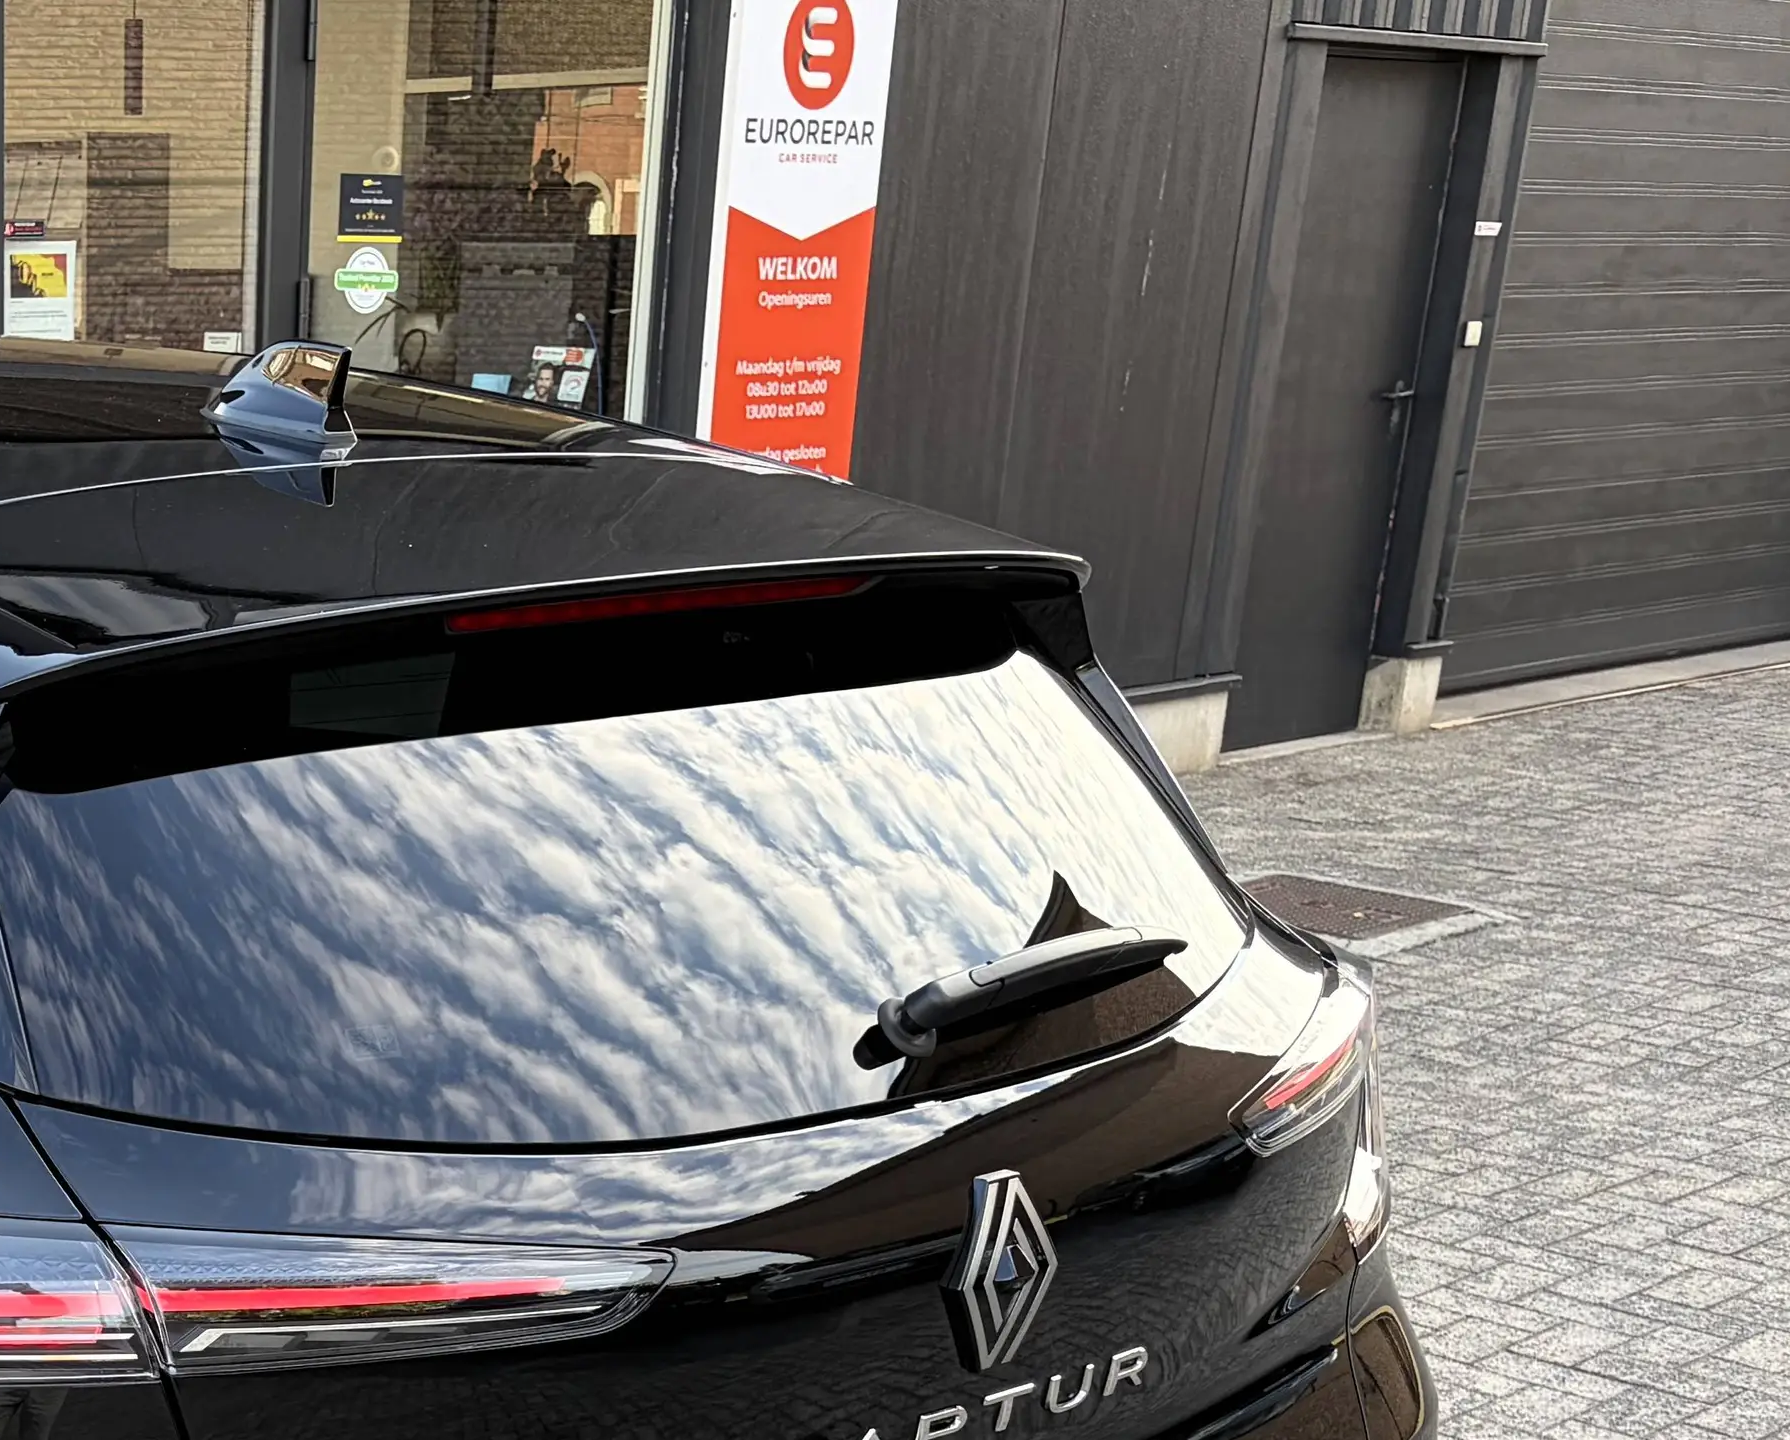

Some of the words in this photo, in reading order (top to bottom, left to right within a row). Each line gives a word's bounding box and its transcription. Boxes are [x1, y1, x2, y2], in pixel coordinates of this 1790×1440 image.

[744, 117, 875, 146] EUROREPAR
[778, 153, 798, 163] CAR
[800, 153, 838, 164] SERVICE
[758, 255, 838, 281] WELKOM
[758, 290, 832, 310] Openingsuren
[735, 356, 784, 377] Maandag
[785, 356, 805, 376] t/m
[806, 355, 842, 376] vrijdag
[780, 380, 797, 396] tot
[778, 402, 795, 418] tot
[782, 444, 827, 463] gesloten
